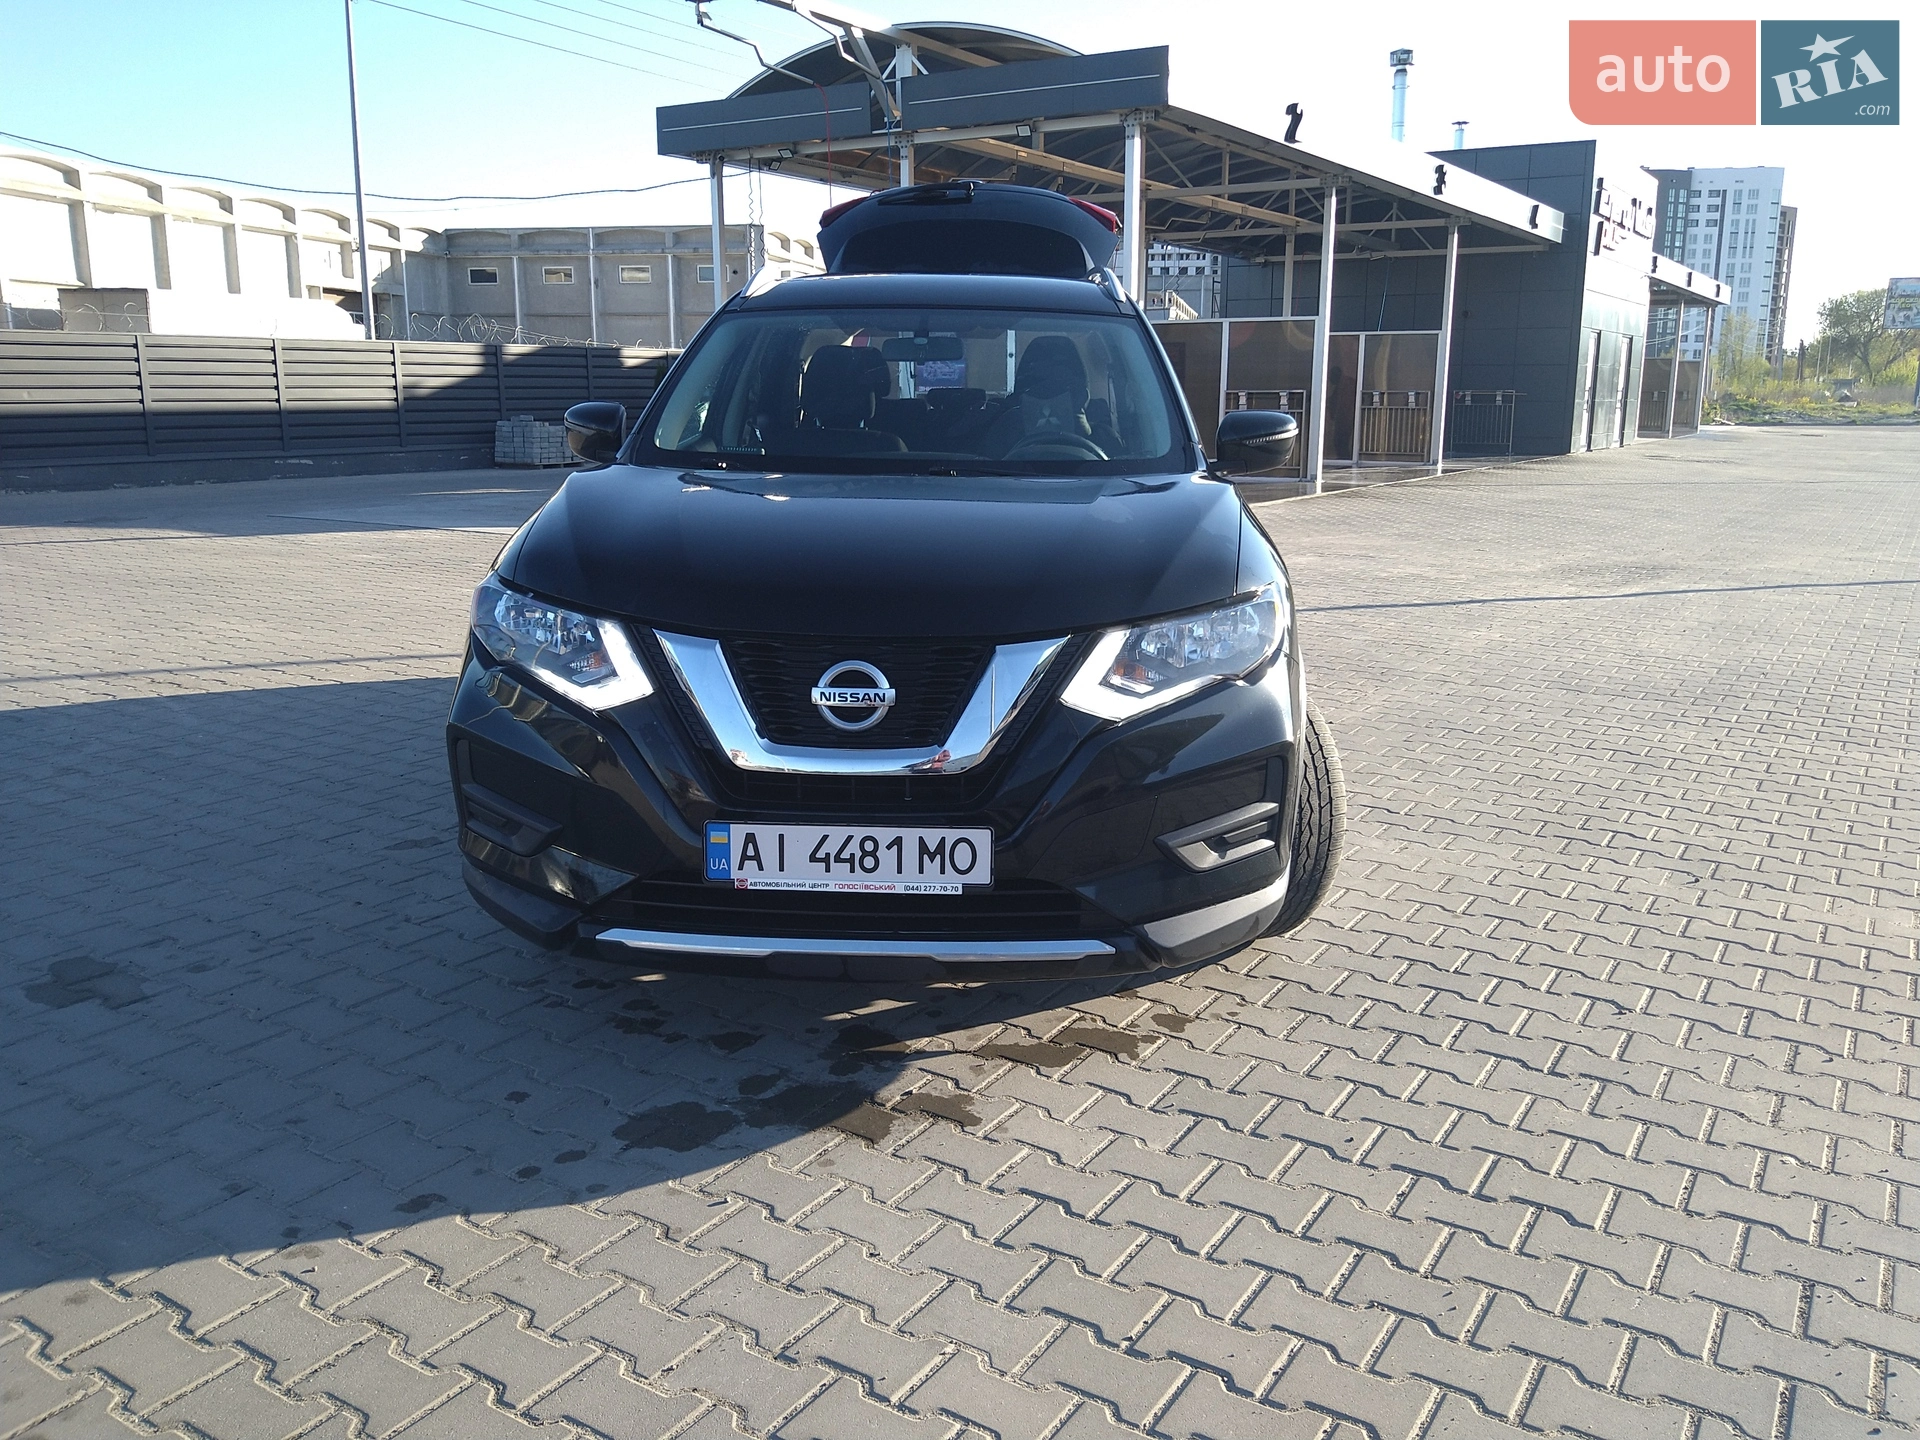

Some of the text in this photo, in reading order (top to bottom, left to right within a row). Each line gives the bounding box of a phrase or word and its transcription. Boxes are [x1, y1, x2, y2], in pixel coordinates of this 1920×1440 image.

[819, 691, 886, 703] NISSAN
[737, 832, 977, 875] AI 4481 MO
[710, 858, 728, 870] UA
[923, 885, 959, 893] 277-70-70
